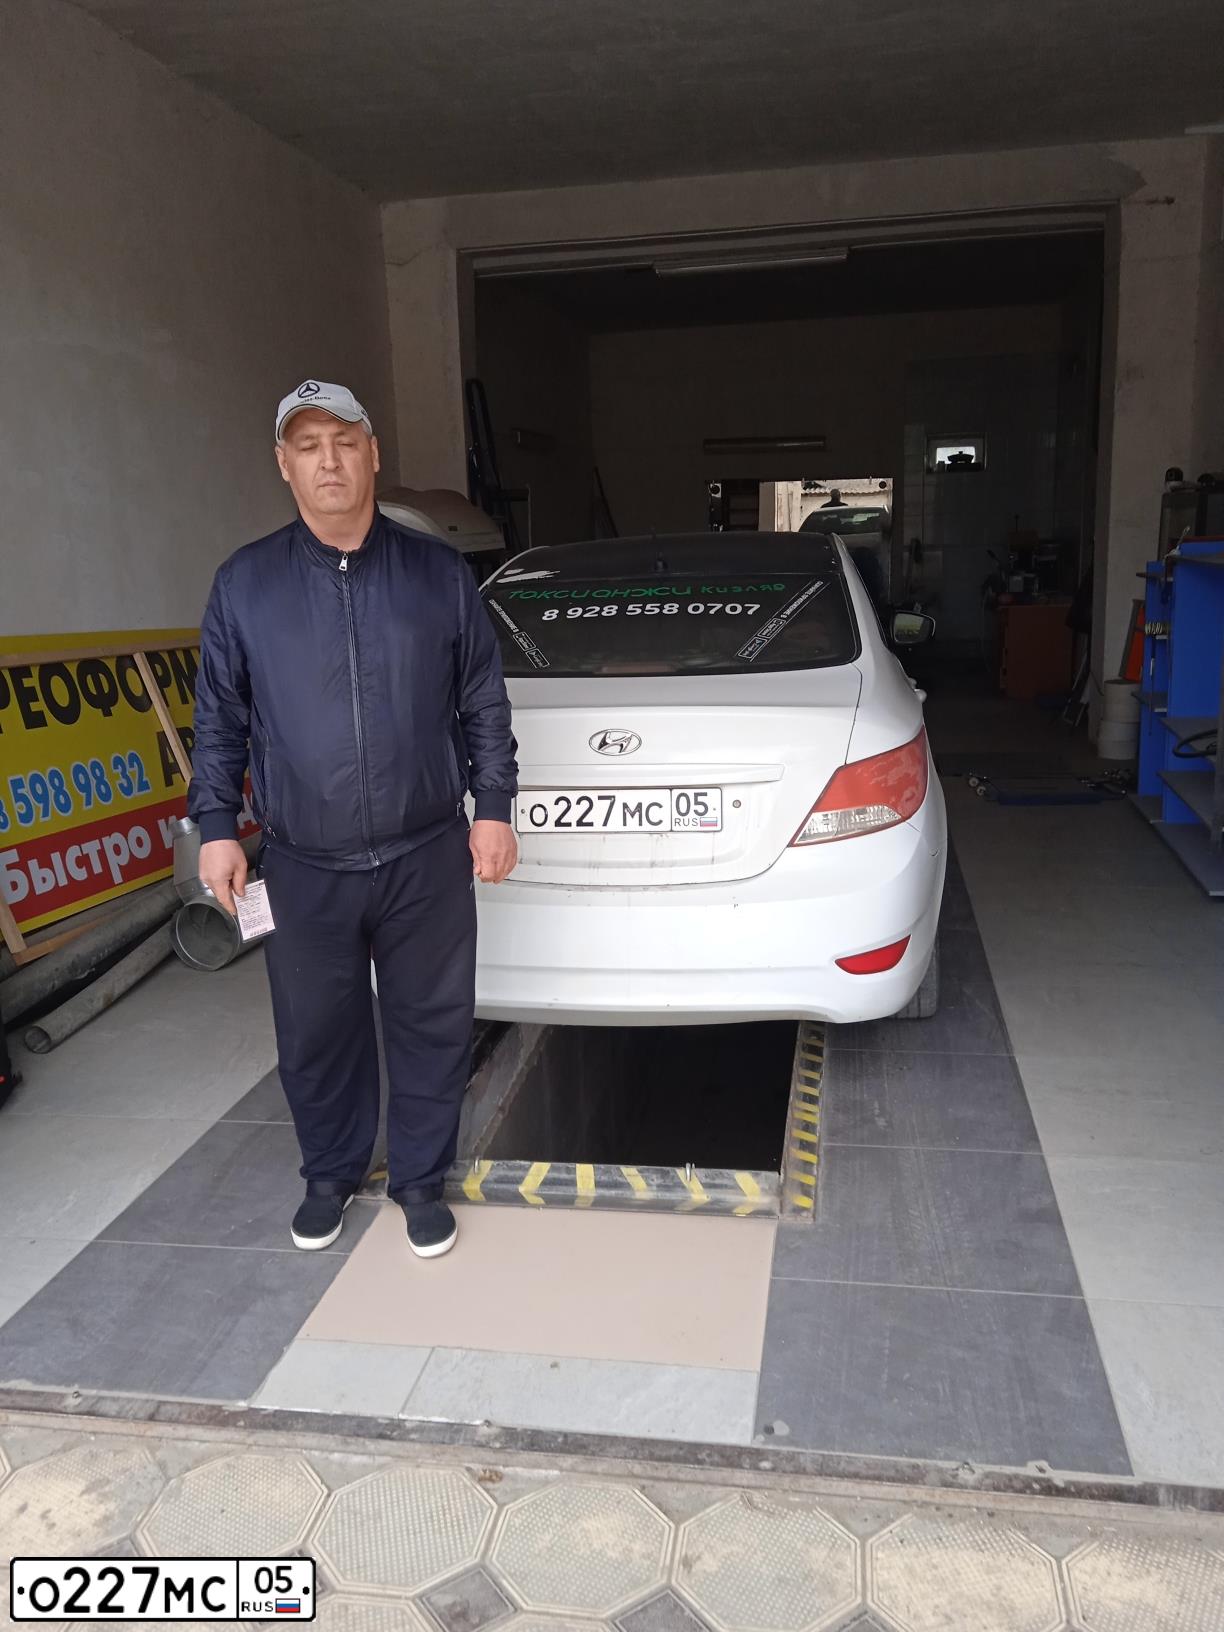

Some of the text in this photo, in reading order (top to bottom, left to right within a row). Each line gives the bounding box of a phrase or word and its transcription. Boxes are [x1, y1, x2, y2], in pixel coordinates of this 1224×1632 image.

[541, 602, 761, 621] 8 928 558 0707
[0, 650, 201, 733] ЕОФОРМ
[9, 767, 73, 826] 598
[71, 758, 113, 809] 98
[111, 750, 152, 798] 32
[675, 792, 709, 817] 05
[674, 817, 699, 827] RUS
[0, 825, 152, 905] Быстро
